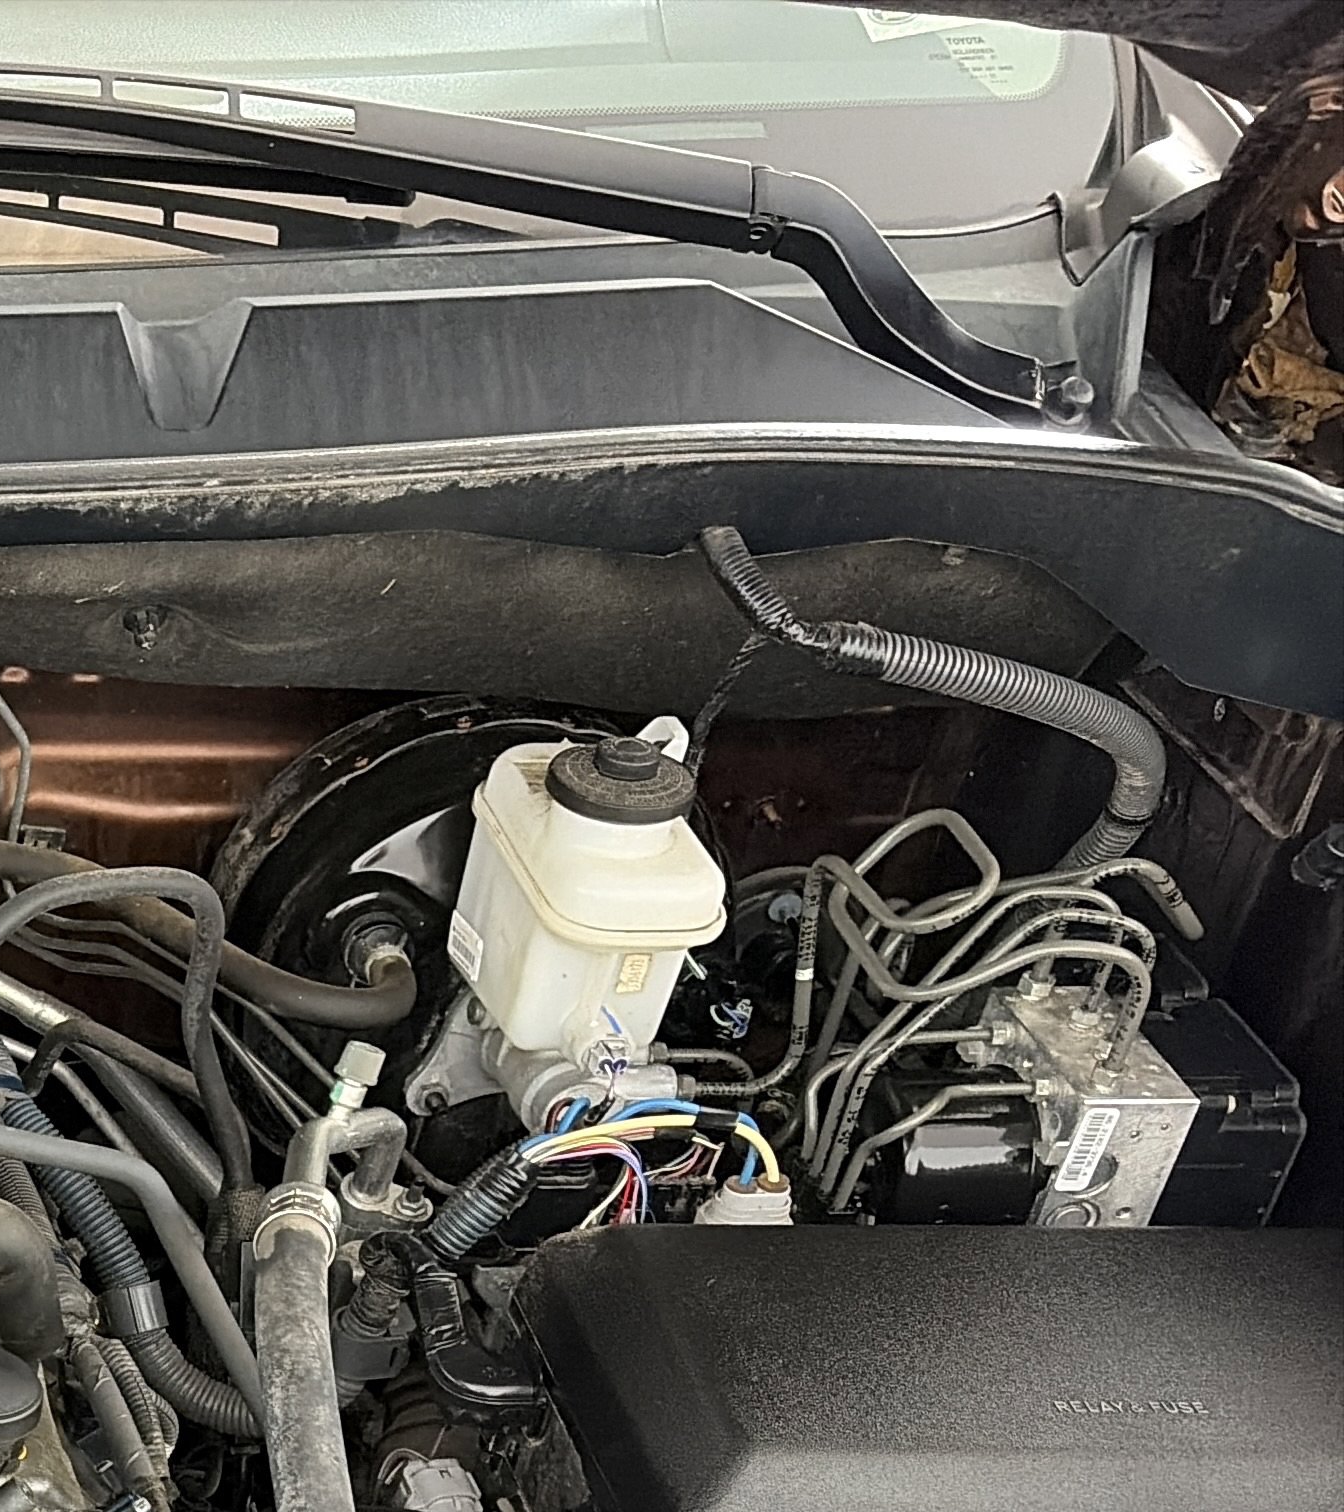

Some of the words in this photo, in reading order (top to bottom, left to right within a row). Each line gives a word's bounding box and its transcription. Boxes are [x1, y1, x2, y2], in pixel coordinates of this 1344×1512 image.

[946, 37, 985, 45] TOYOTA
[1053, 1400, 1124, 1413] RELAY
[1148, 1400, 1210, 1414] FUSE
